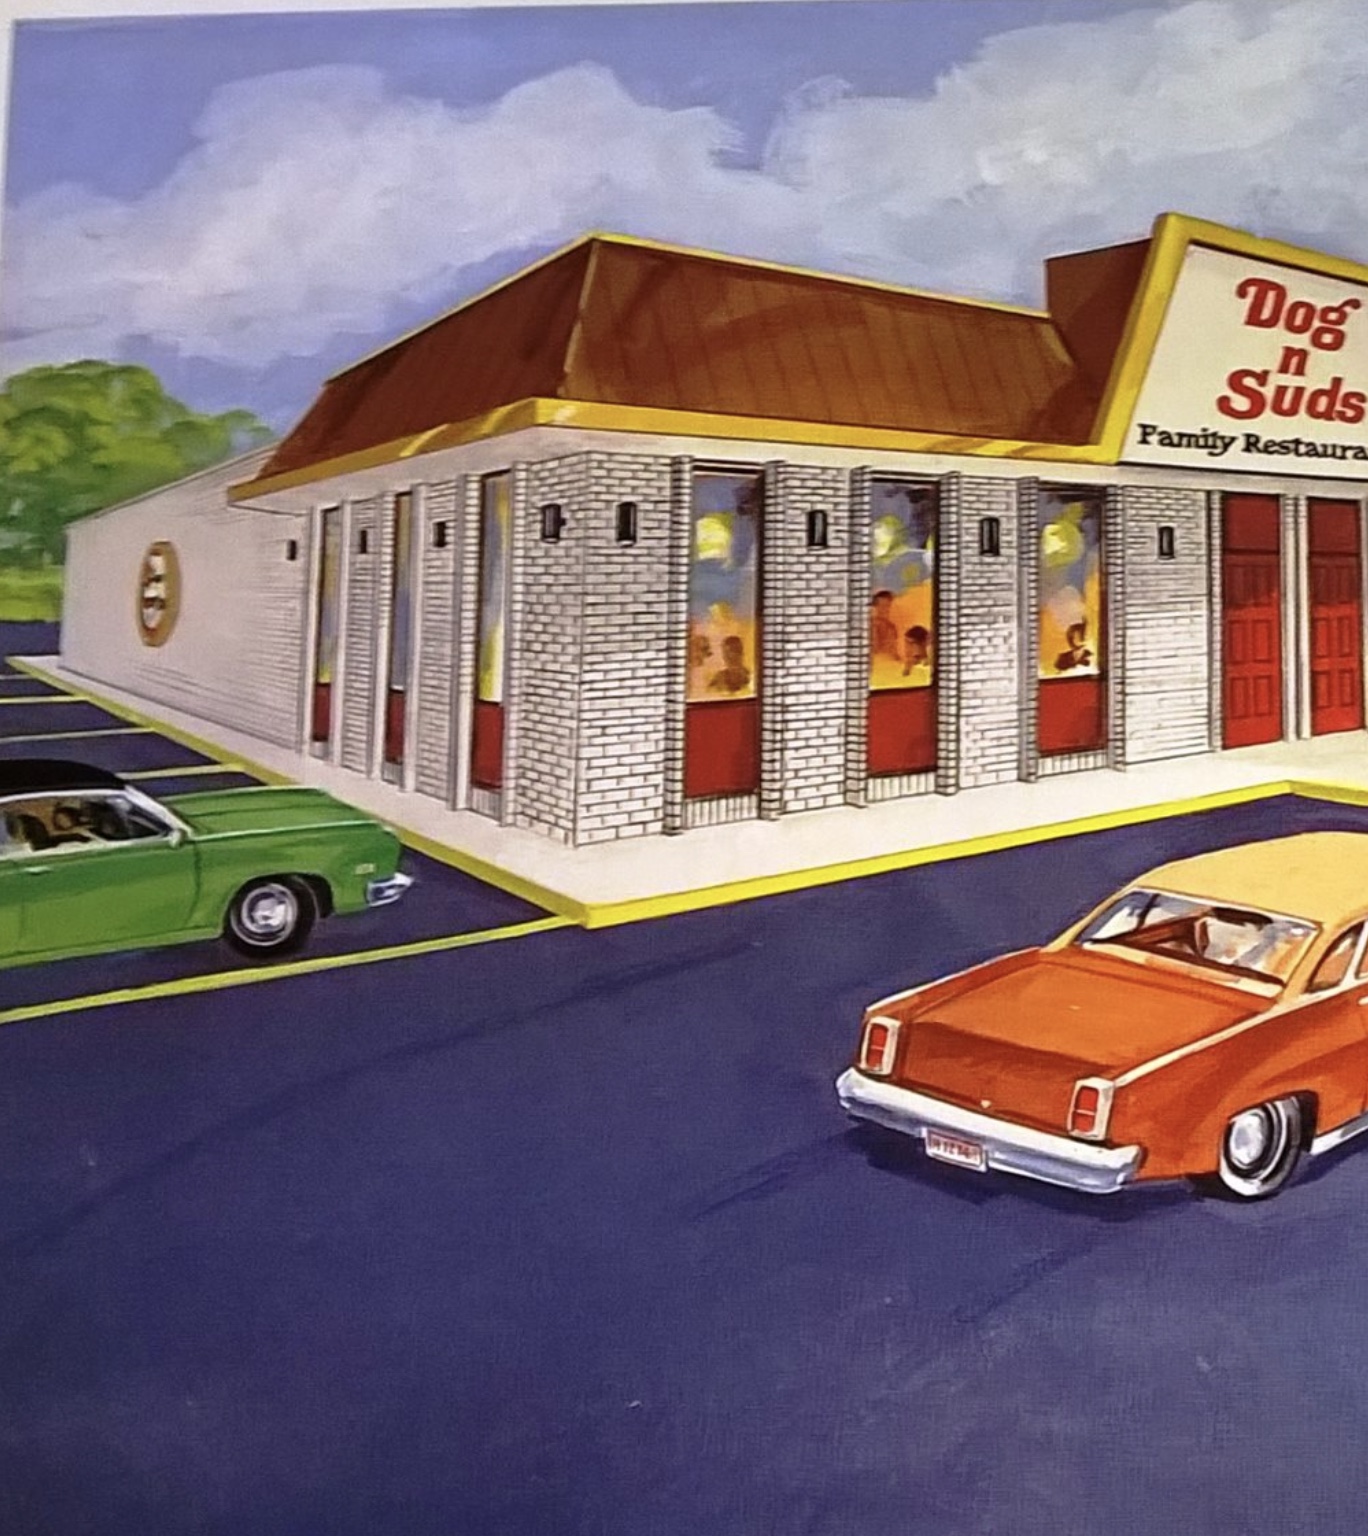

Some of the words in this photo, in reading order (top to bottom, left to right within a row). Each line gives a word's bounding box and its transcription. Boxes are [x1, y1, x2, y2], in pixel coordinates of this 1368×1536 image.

[1236, 277, 1362, 351] Dog
[1277, 346, 1310, 376] n
[1216, 369, 1368, 424] Suds
[1137, 423, 1237, 457] Family
